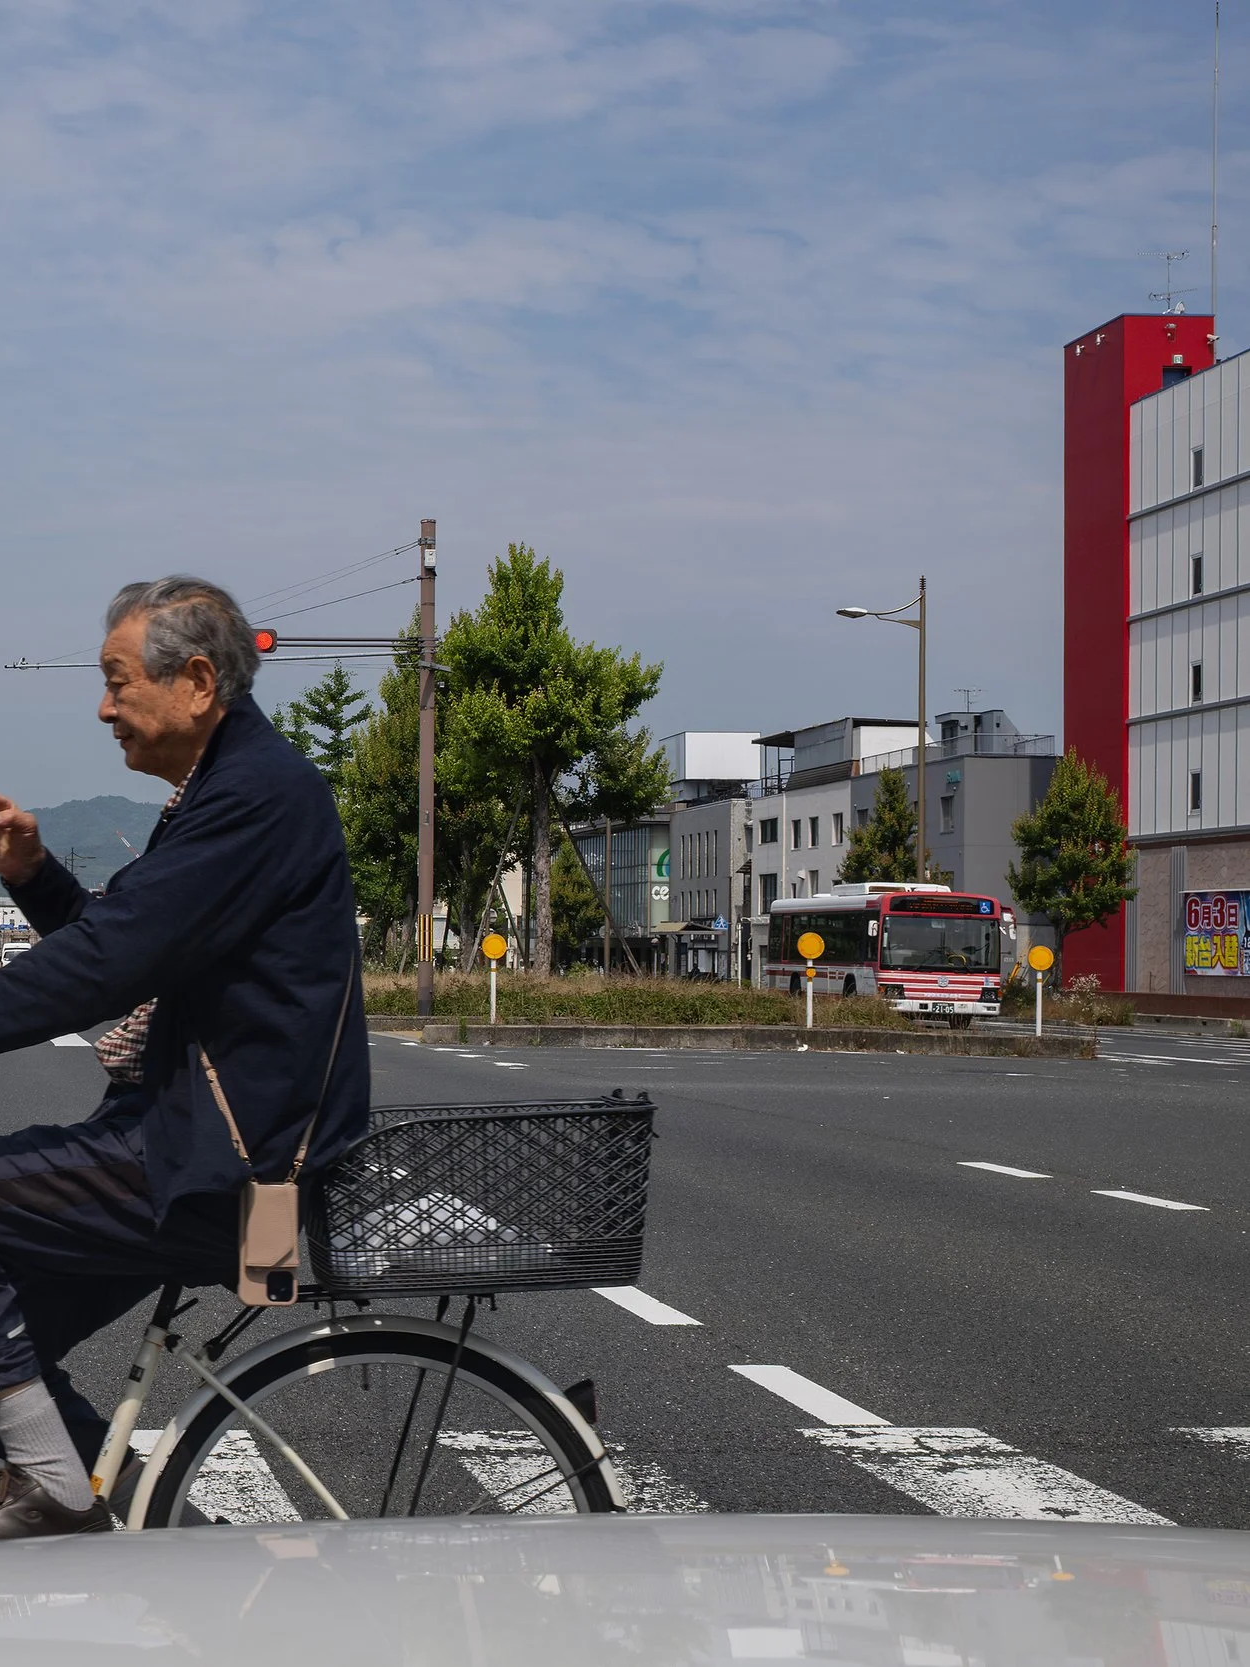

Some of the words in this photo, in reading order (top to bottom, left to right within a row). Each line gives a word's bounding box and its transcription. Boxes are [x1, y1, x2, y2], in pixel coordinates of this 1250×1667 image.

[1186, 896, 1239, 931] 6月3日
[1185, 933, 1239, 969] 新台入替
[935, 1006, 954, 1014] 21-05
